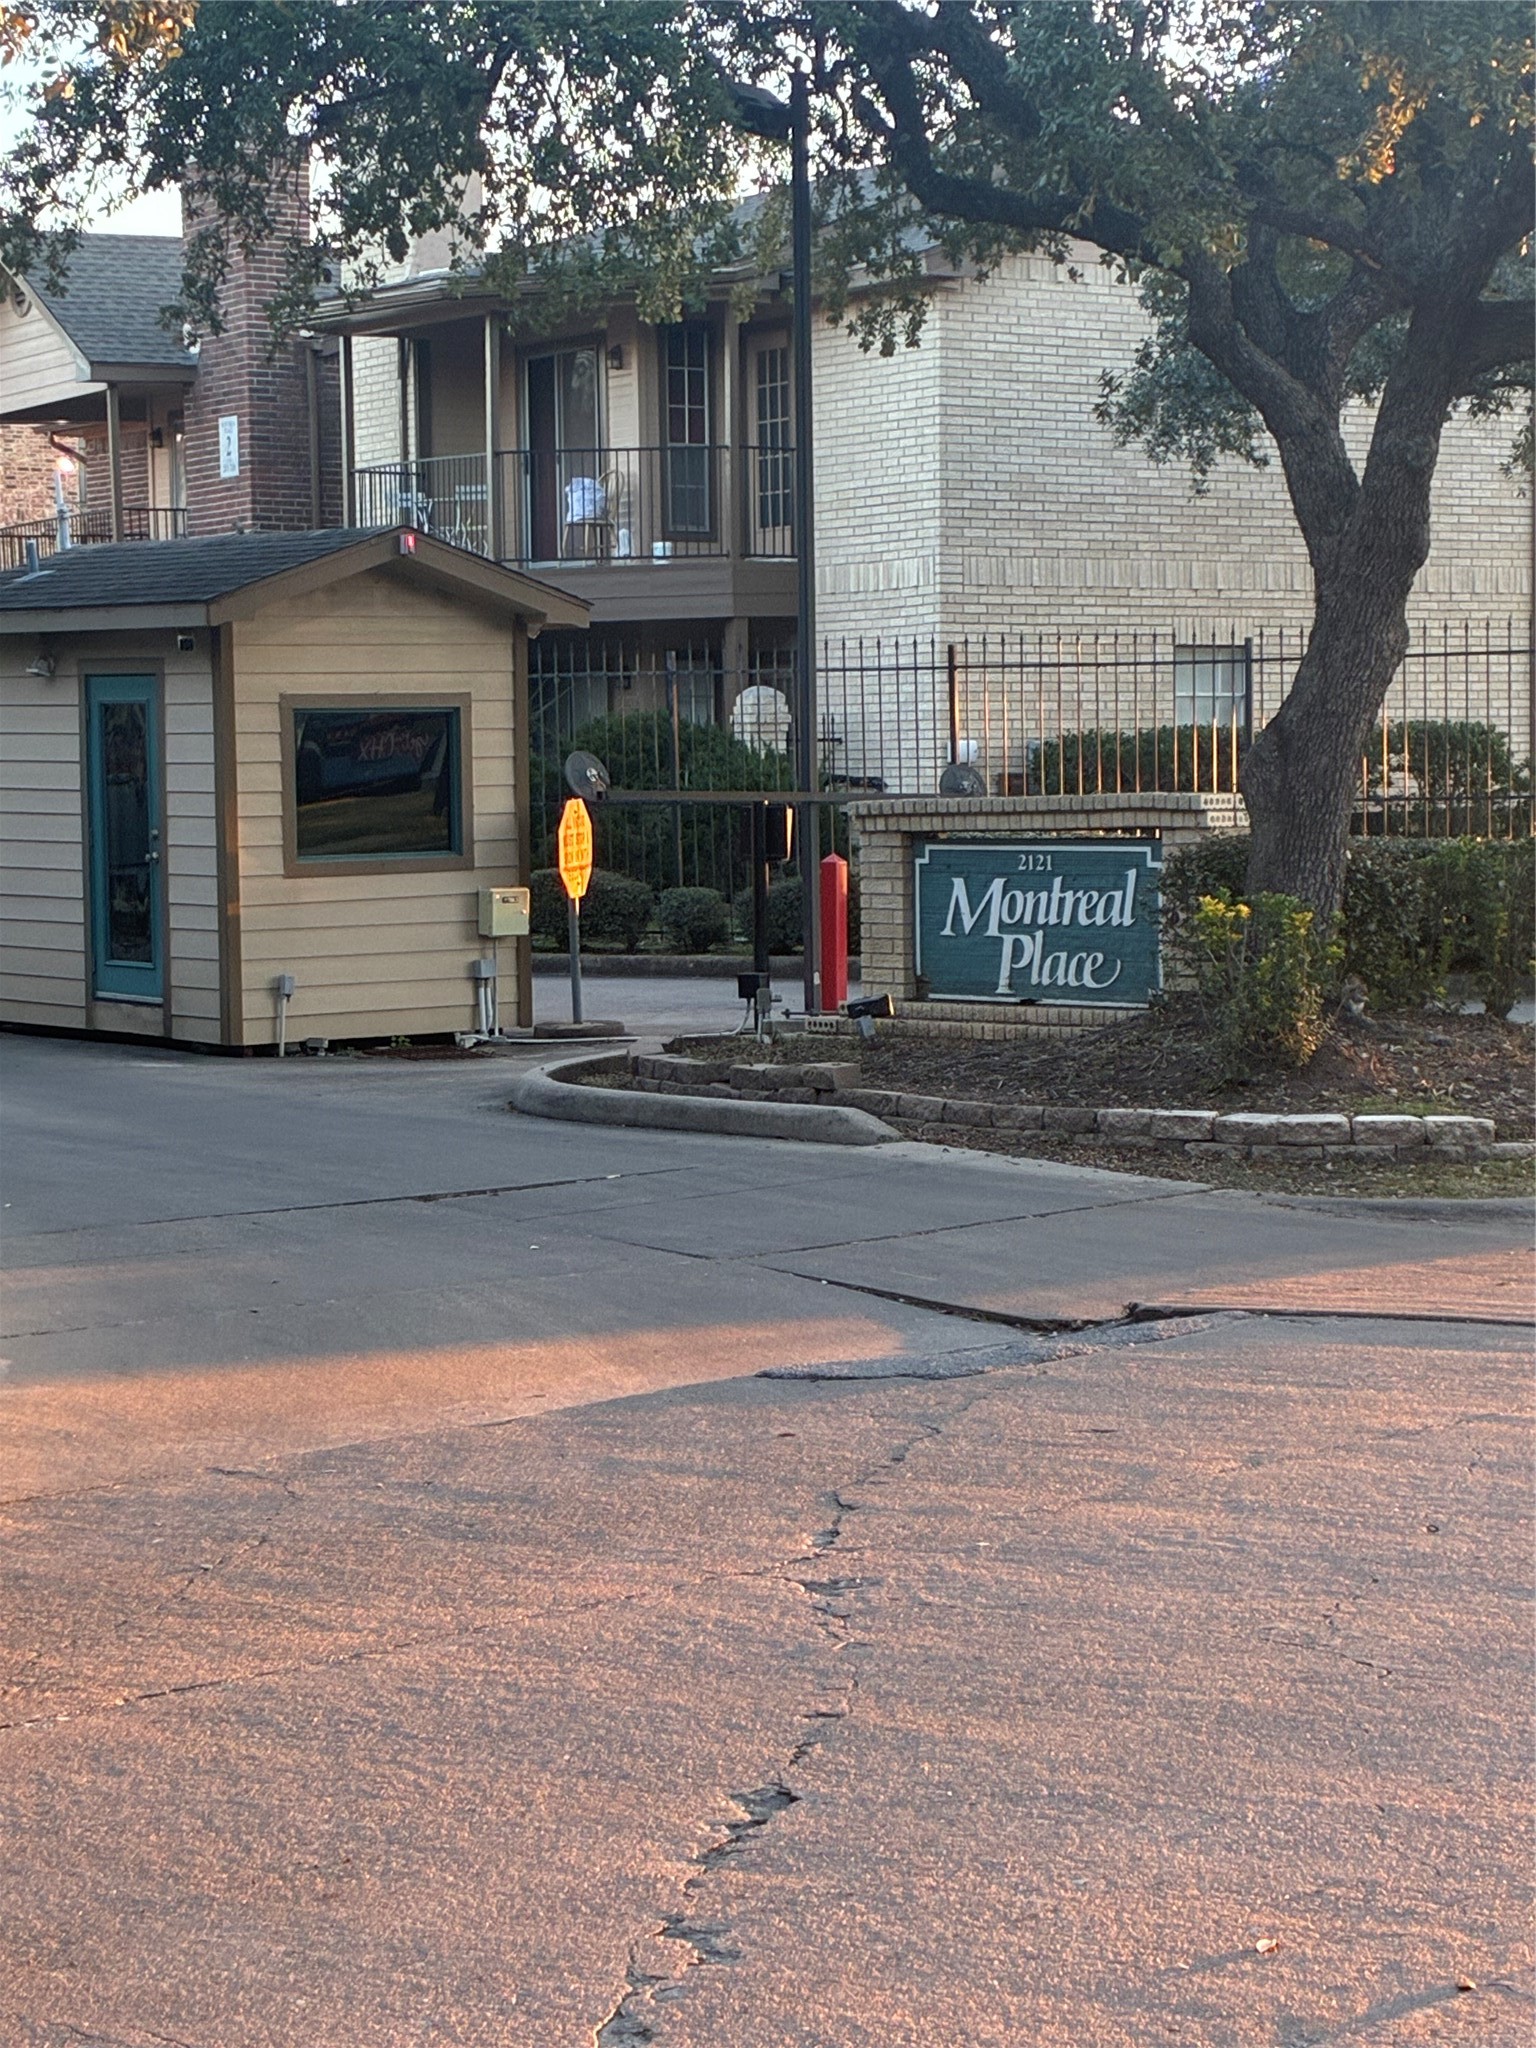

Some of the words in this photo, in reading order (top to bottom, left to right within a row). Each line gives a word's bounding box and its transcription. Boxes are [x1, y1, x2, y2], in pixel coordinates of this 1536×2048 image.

[226, 435, 232, 457] 2
[1018, 854, 1053, 871] 2121
[940, 868, 1137, 937] Montreal
[995, 930, 1121, 995] Place
